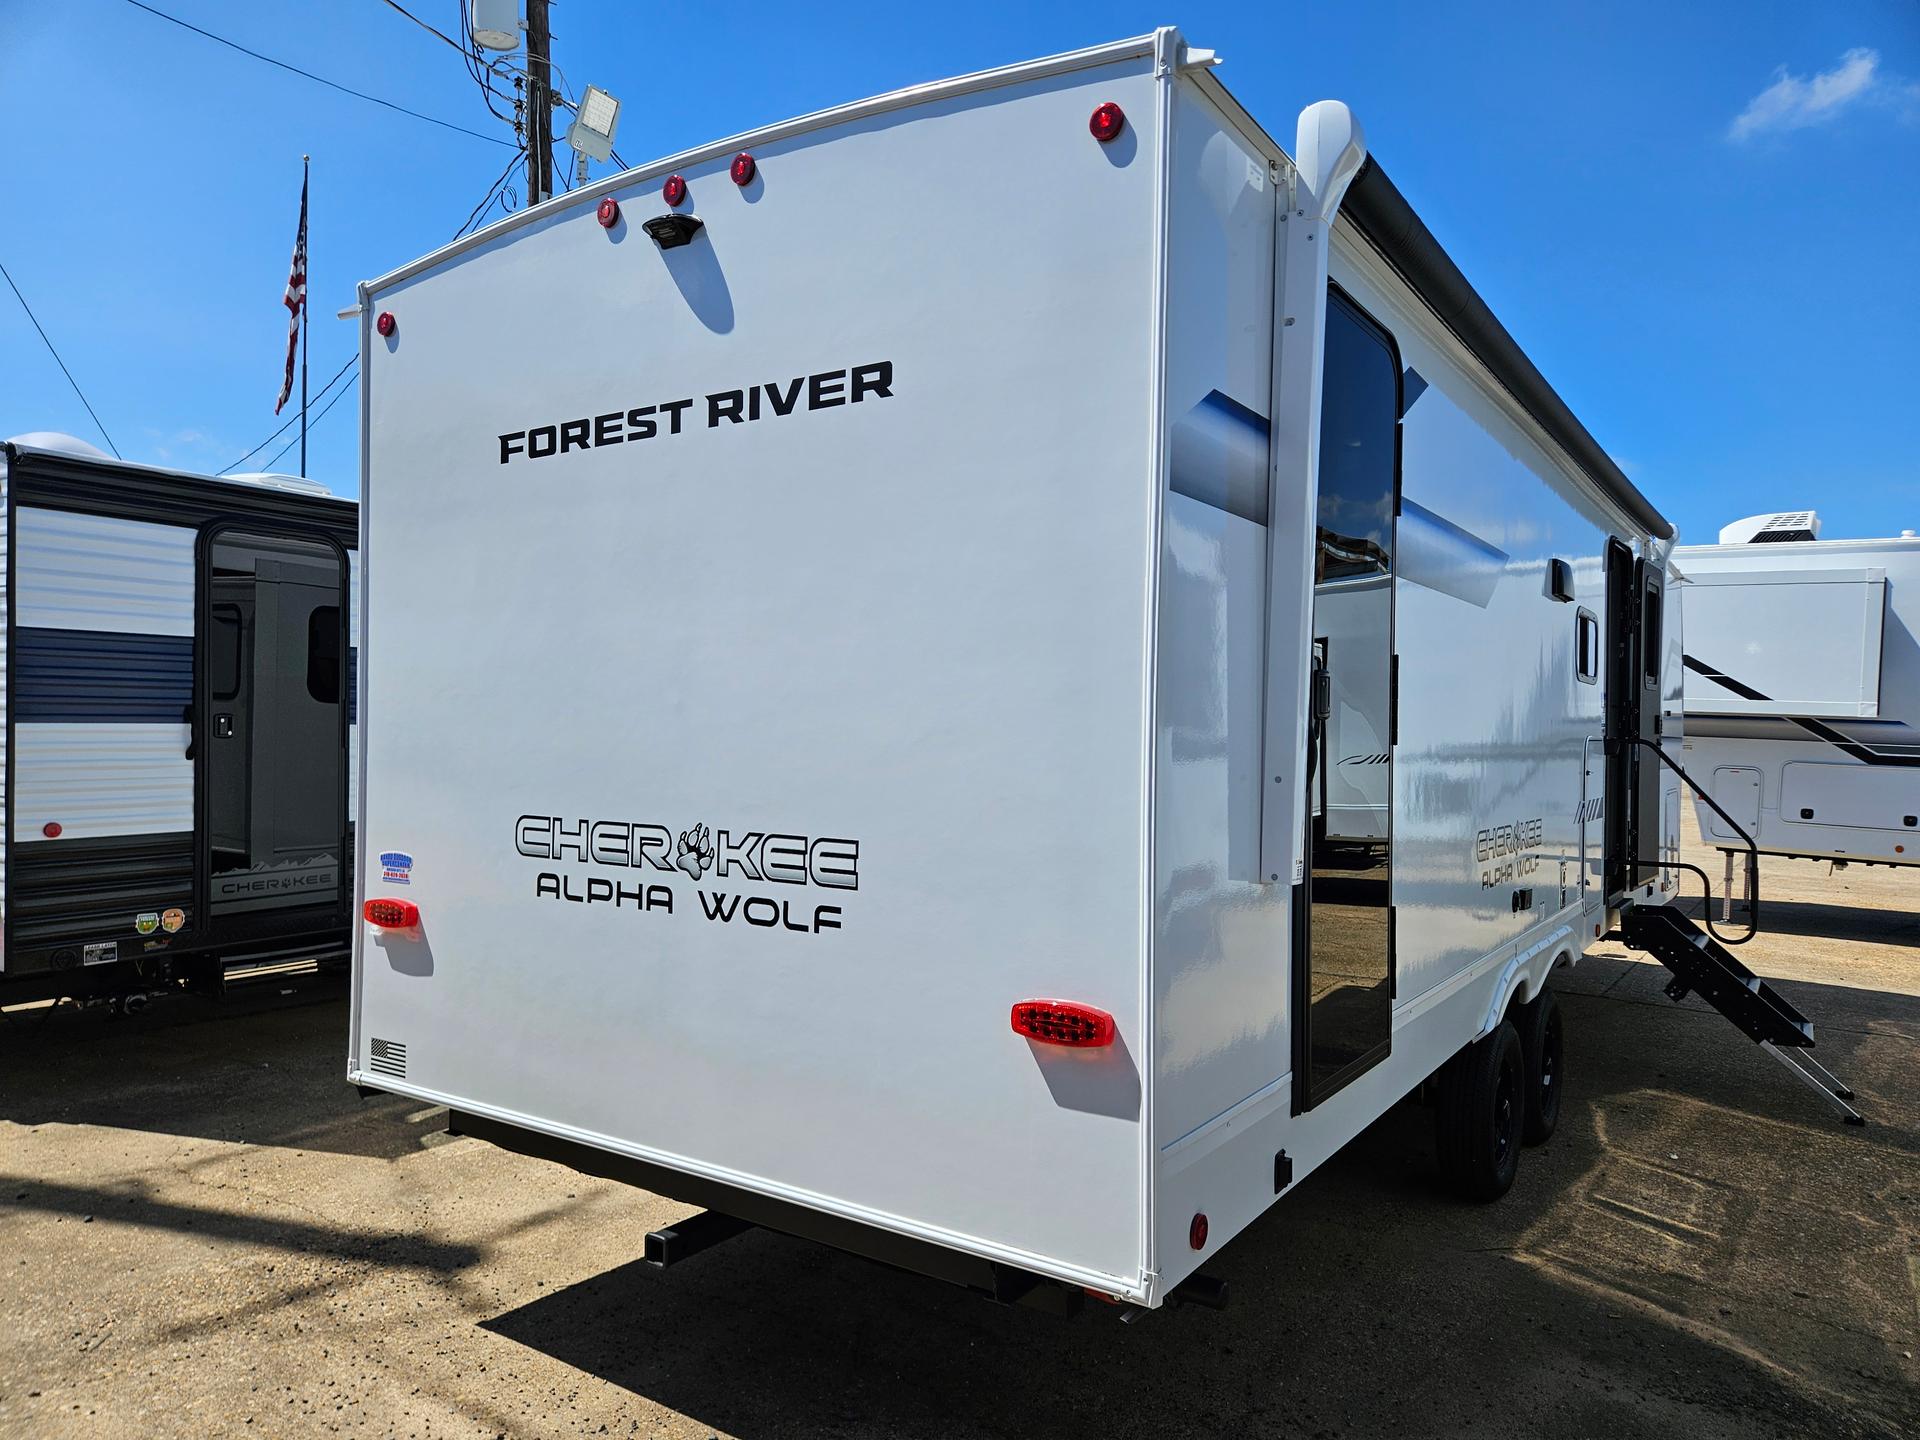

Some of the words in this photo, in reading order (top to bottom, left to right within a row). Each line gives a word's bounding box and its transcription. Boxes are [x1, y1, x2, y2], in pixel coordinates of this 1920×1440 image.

[498, 398, 694, 464] FOREST
[704, 360, 894, 428] RIVER
[515, 814, 860, 891] CHERKEE
[1476, 818, 1542, 862] CHERKEE
[221, 873, 331, 894] CHERKEE
[1481, 863, 1513, 891] ALPHA
[1516, 854, 1540, 878] WOLF
[536, 872, 673, 914] ALPHA
[697, 890, 842, 934] WOLF
